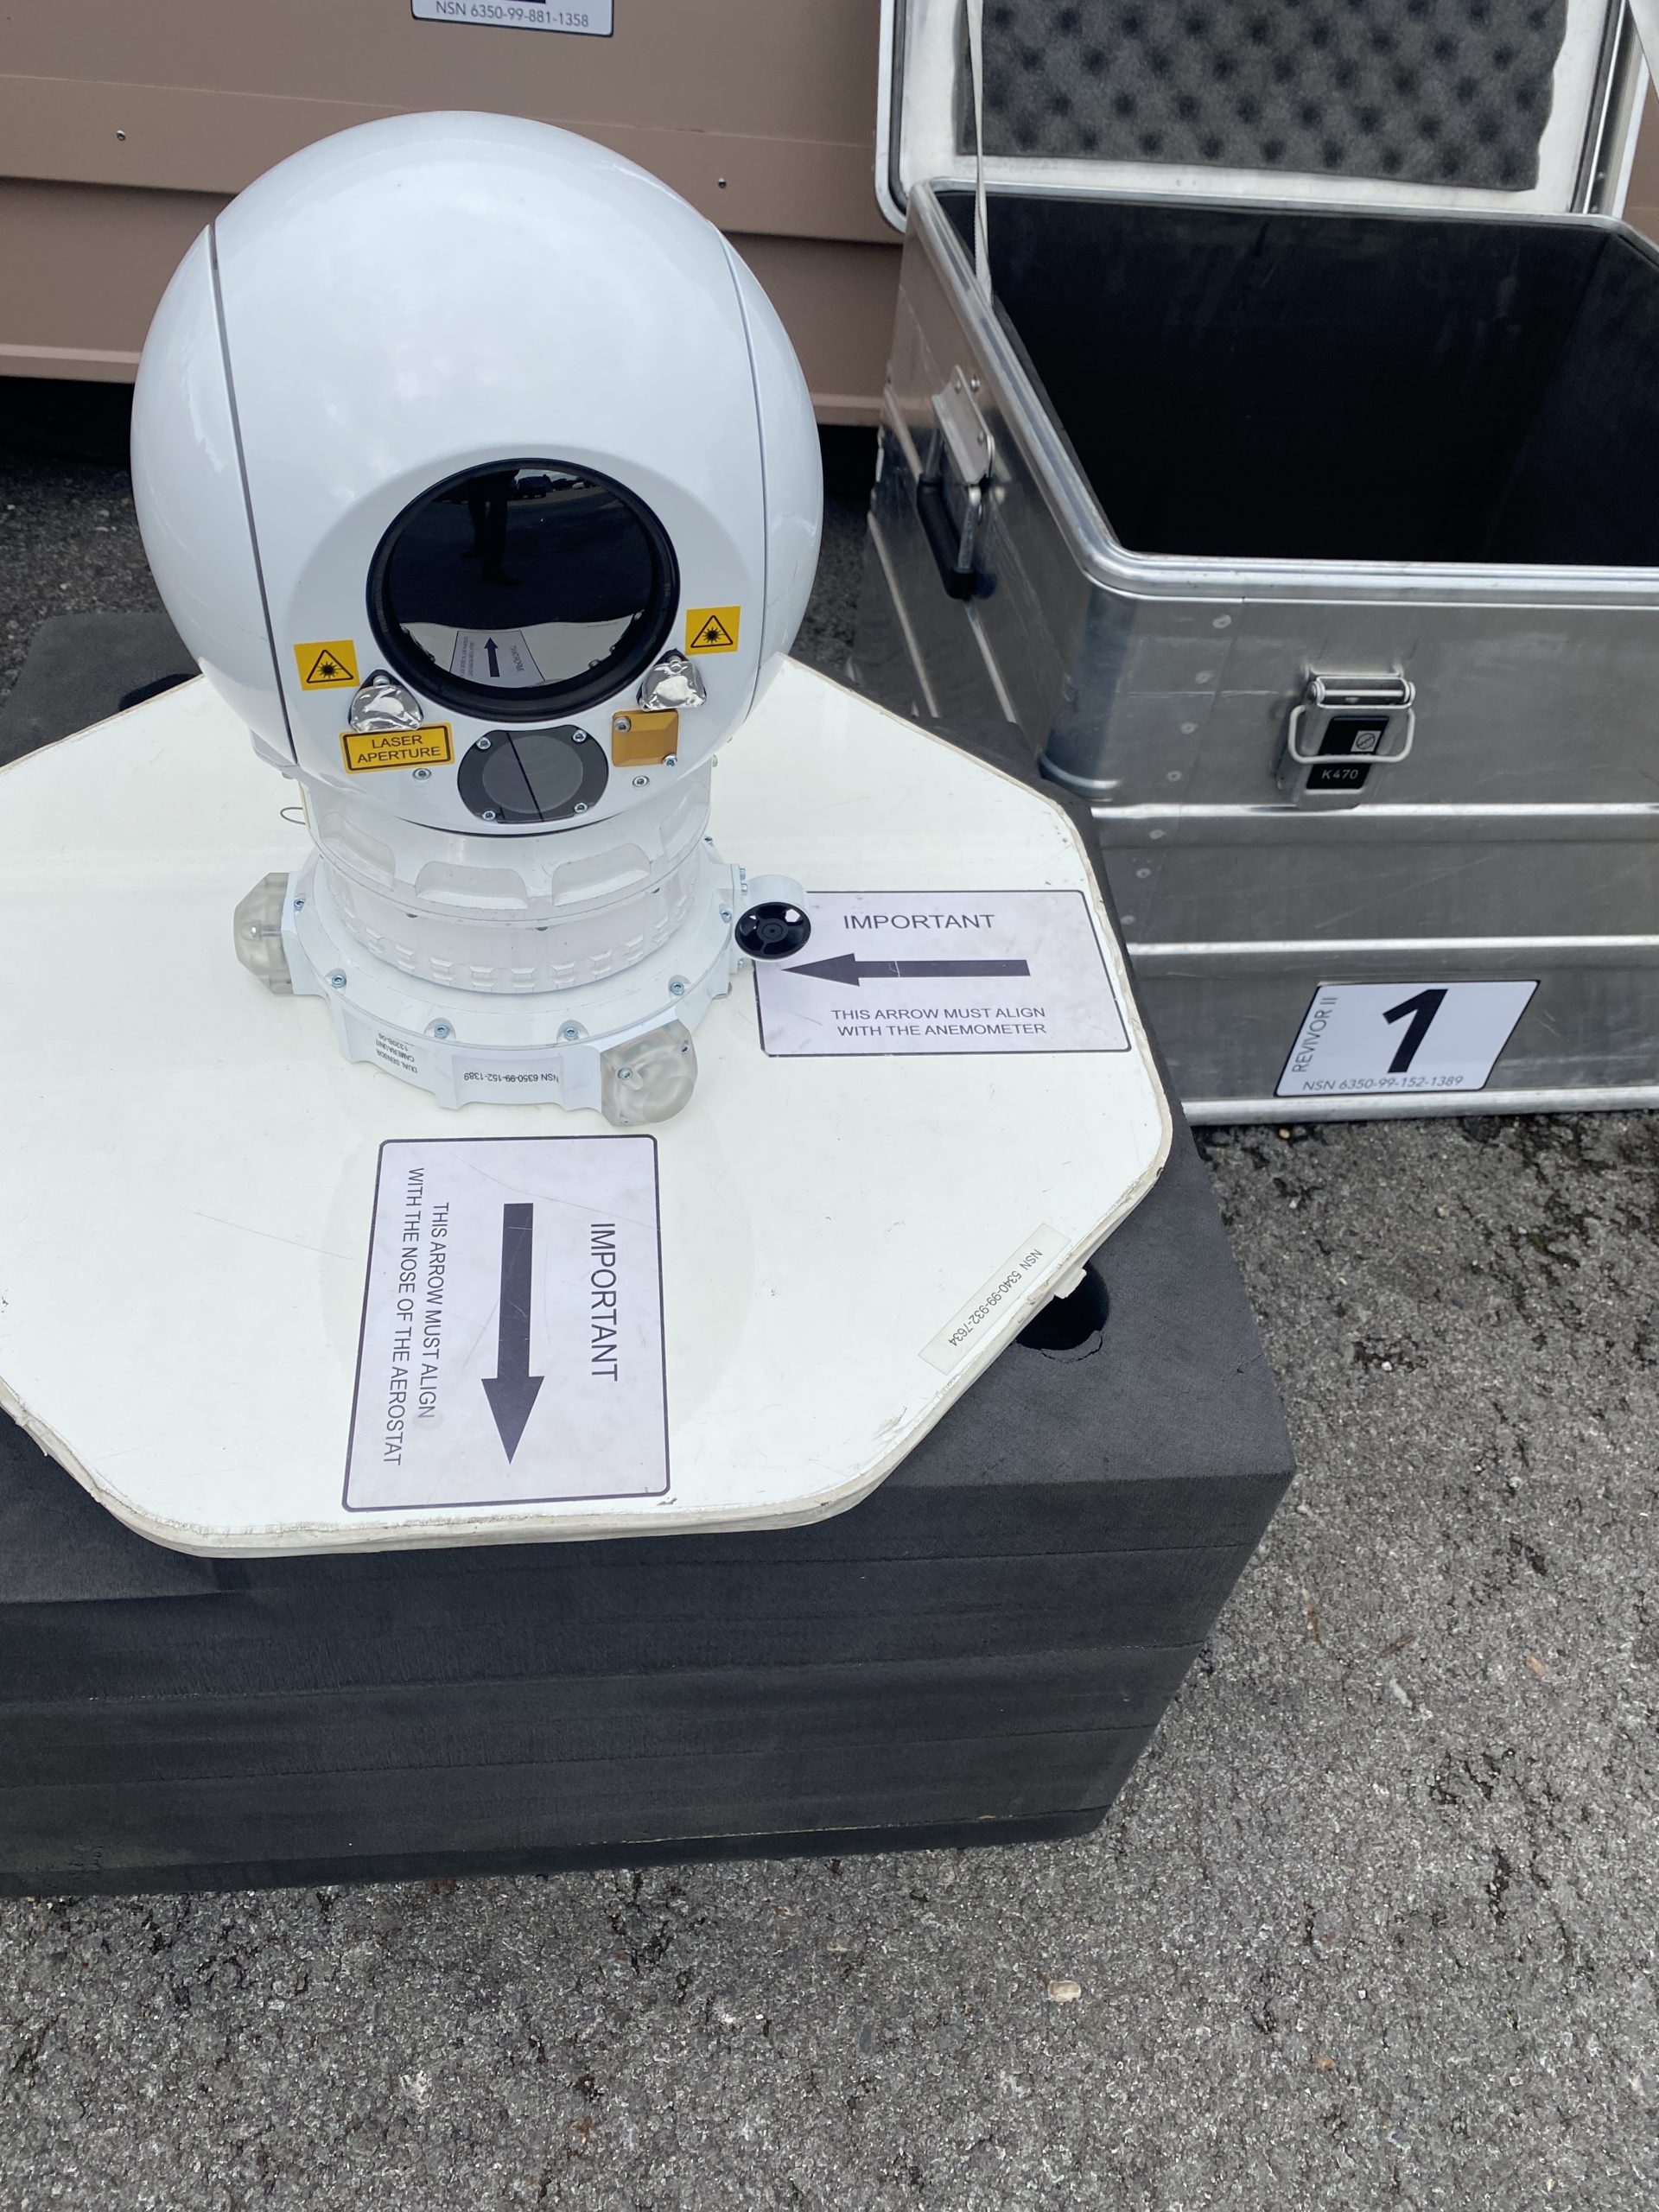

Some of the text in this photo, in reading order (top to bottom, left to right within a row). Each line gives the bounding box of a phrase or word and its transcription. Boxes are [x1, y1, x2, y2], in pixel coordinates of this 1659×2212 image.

[435, 1, 589, 27] NSN 6350-99-881-1358
[372, 735, 423, 750] LASER
[358, 746, 442, 762] APERTURE
[1322, 769, 1358, 779] K470
[843, 914, 995, 929] IMPORTANT
[831, 1007, 1046, 1020] THIS ARROW MUST ALIGN
[837, 1024, 1047, 1037] WITH THE ANEMOMETER
[1292, 996, 1338, 1072] REVIVOR II
[1382, 988, 1448, 1073] 1
[388, 1046, 415, 1063] CAMERA
[400, 1060, 417, 1073] DUAL
[463, 1071, 559, 1084] NSN 6350-99-152-1389
[1303, 1075, 1464, 1091] NSN 6350-99-152-1389
[590, 1223, 619, 1382] IMPORTANT
[947, 1249, 1044, 1347] NSN 5340-99-932-7634
[384, 1167, 424, 1466] WITH THE NOSE OF THE AEROSTAT
[418, 1202, 448, 1419] THIS ARROW MUST ALIGN
